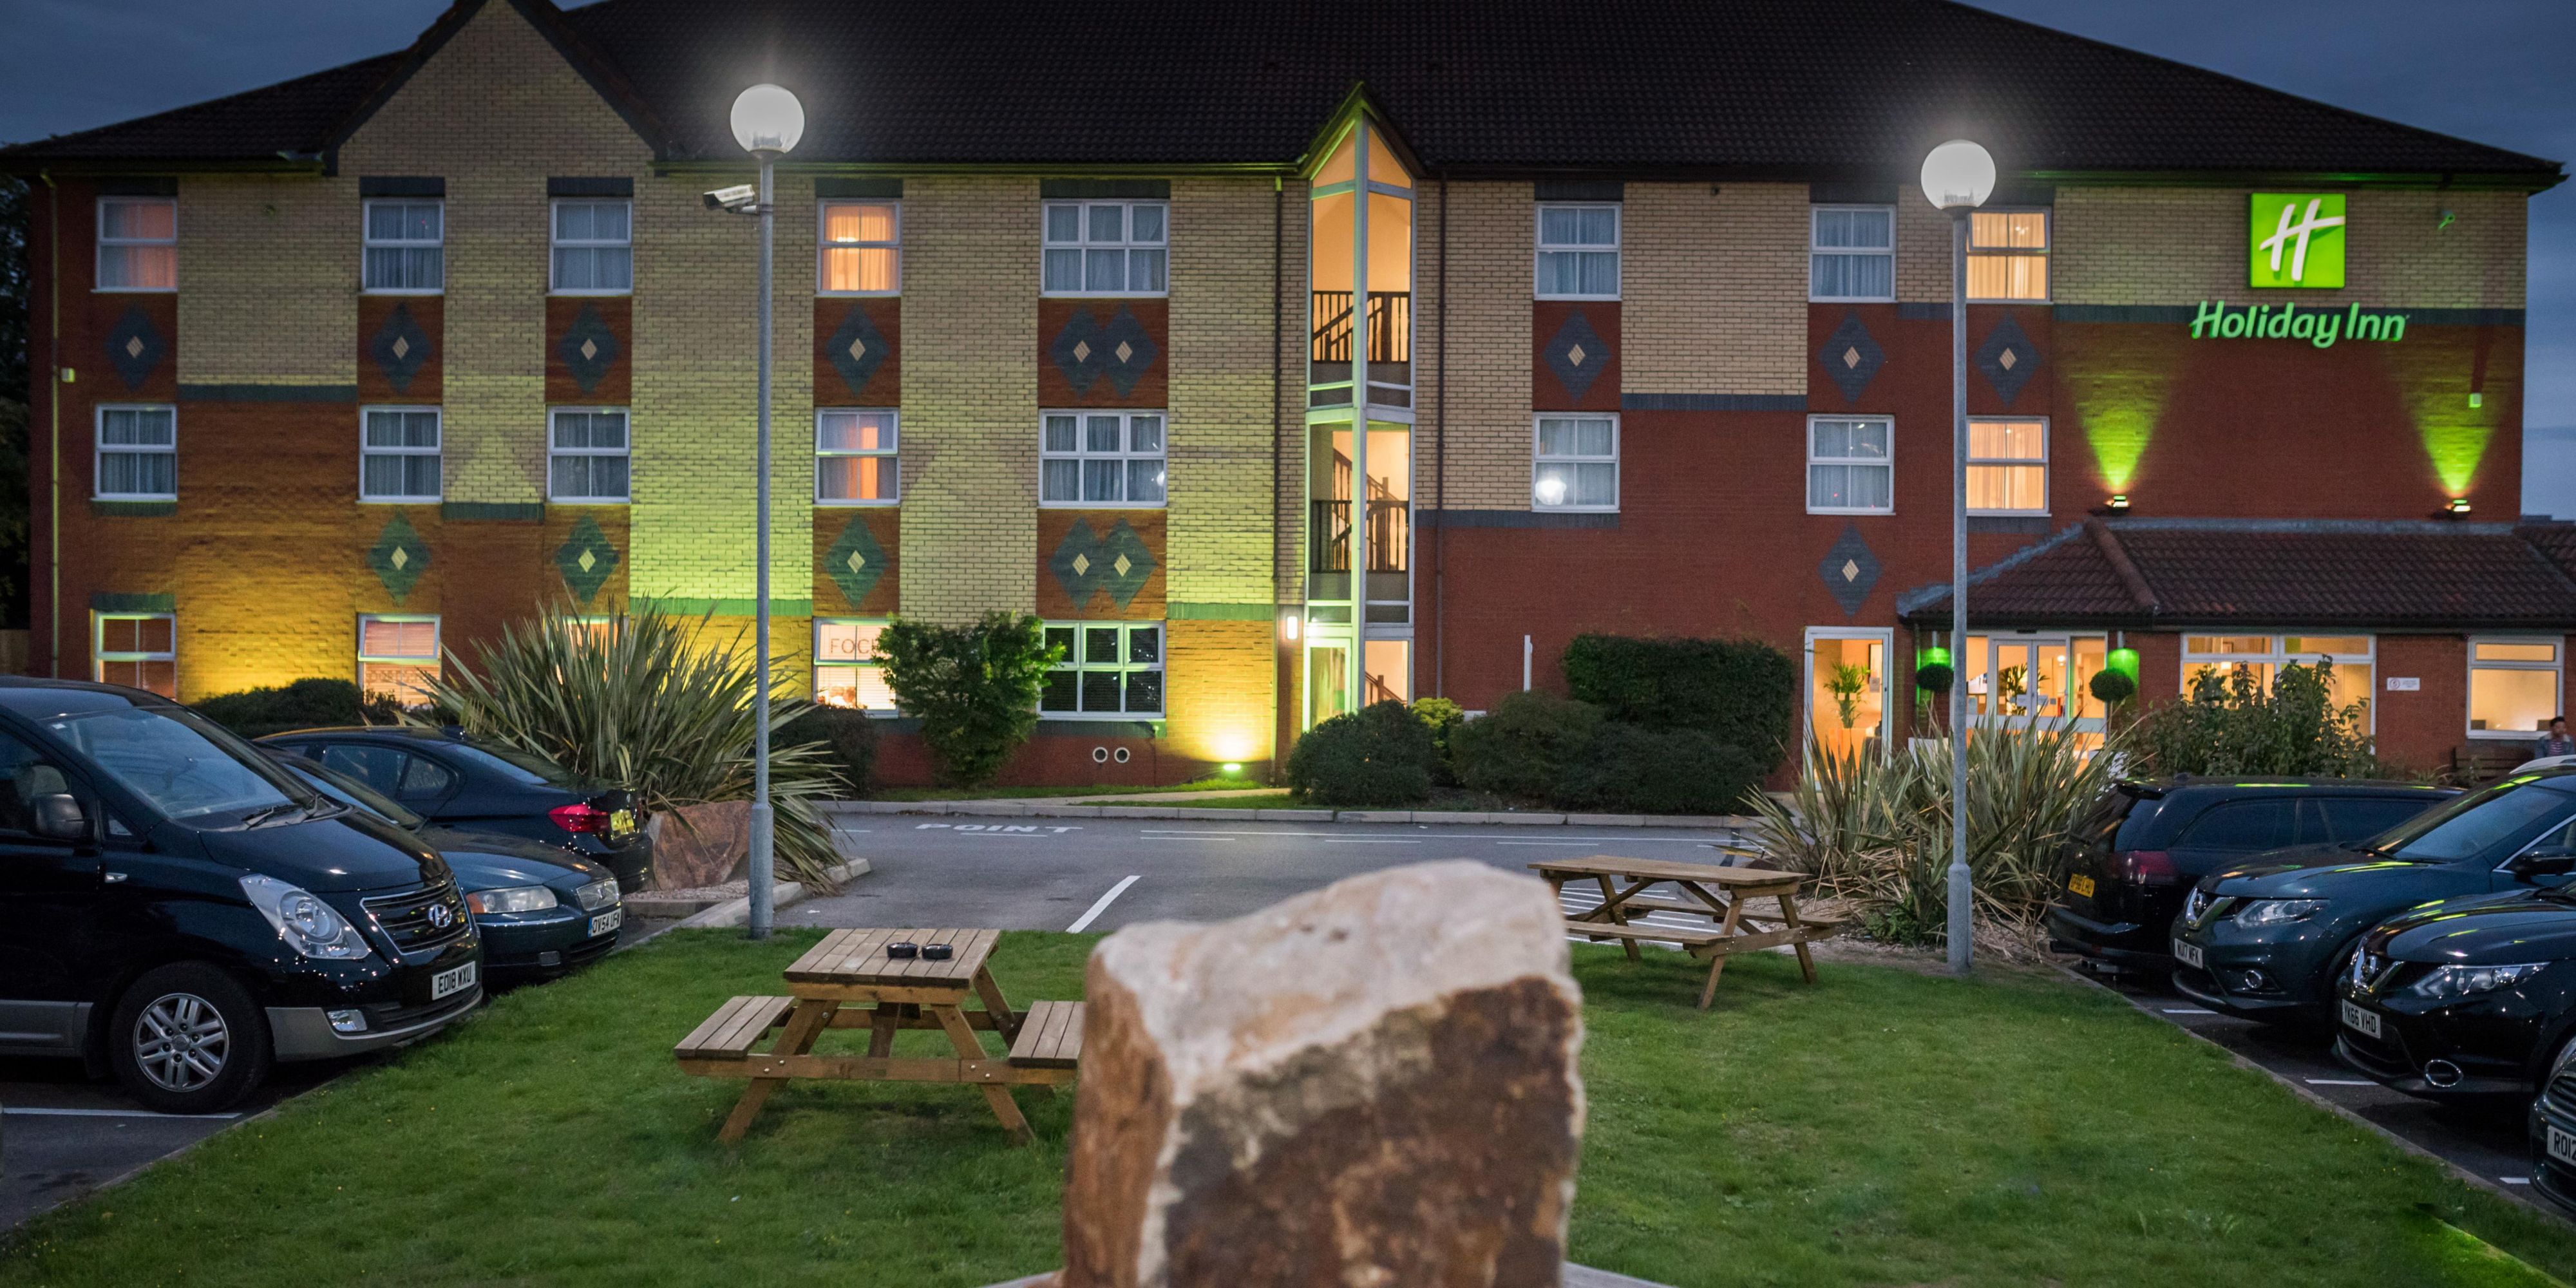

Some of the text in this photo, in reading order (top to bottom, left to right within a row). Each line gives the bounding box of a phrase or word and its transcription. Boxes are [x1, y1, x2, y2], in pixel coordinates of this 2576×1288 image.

[2190, 300, 2406, 348] Holiday Inn
[915, 823, 1083, 833] POINT
[439, 971, 456, 994] EO18
[2344, 1005, 2376, 1033] YK66 VHD
